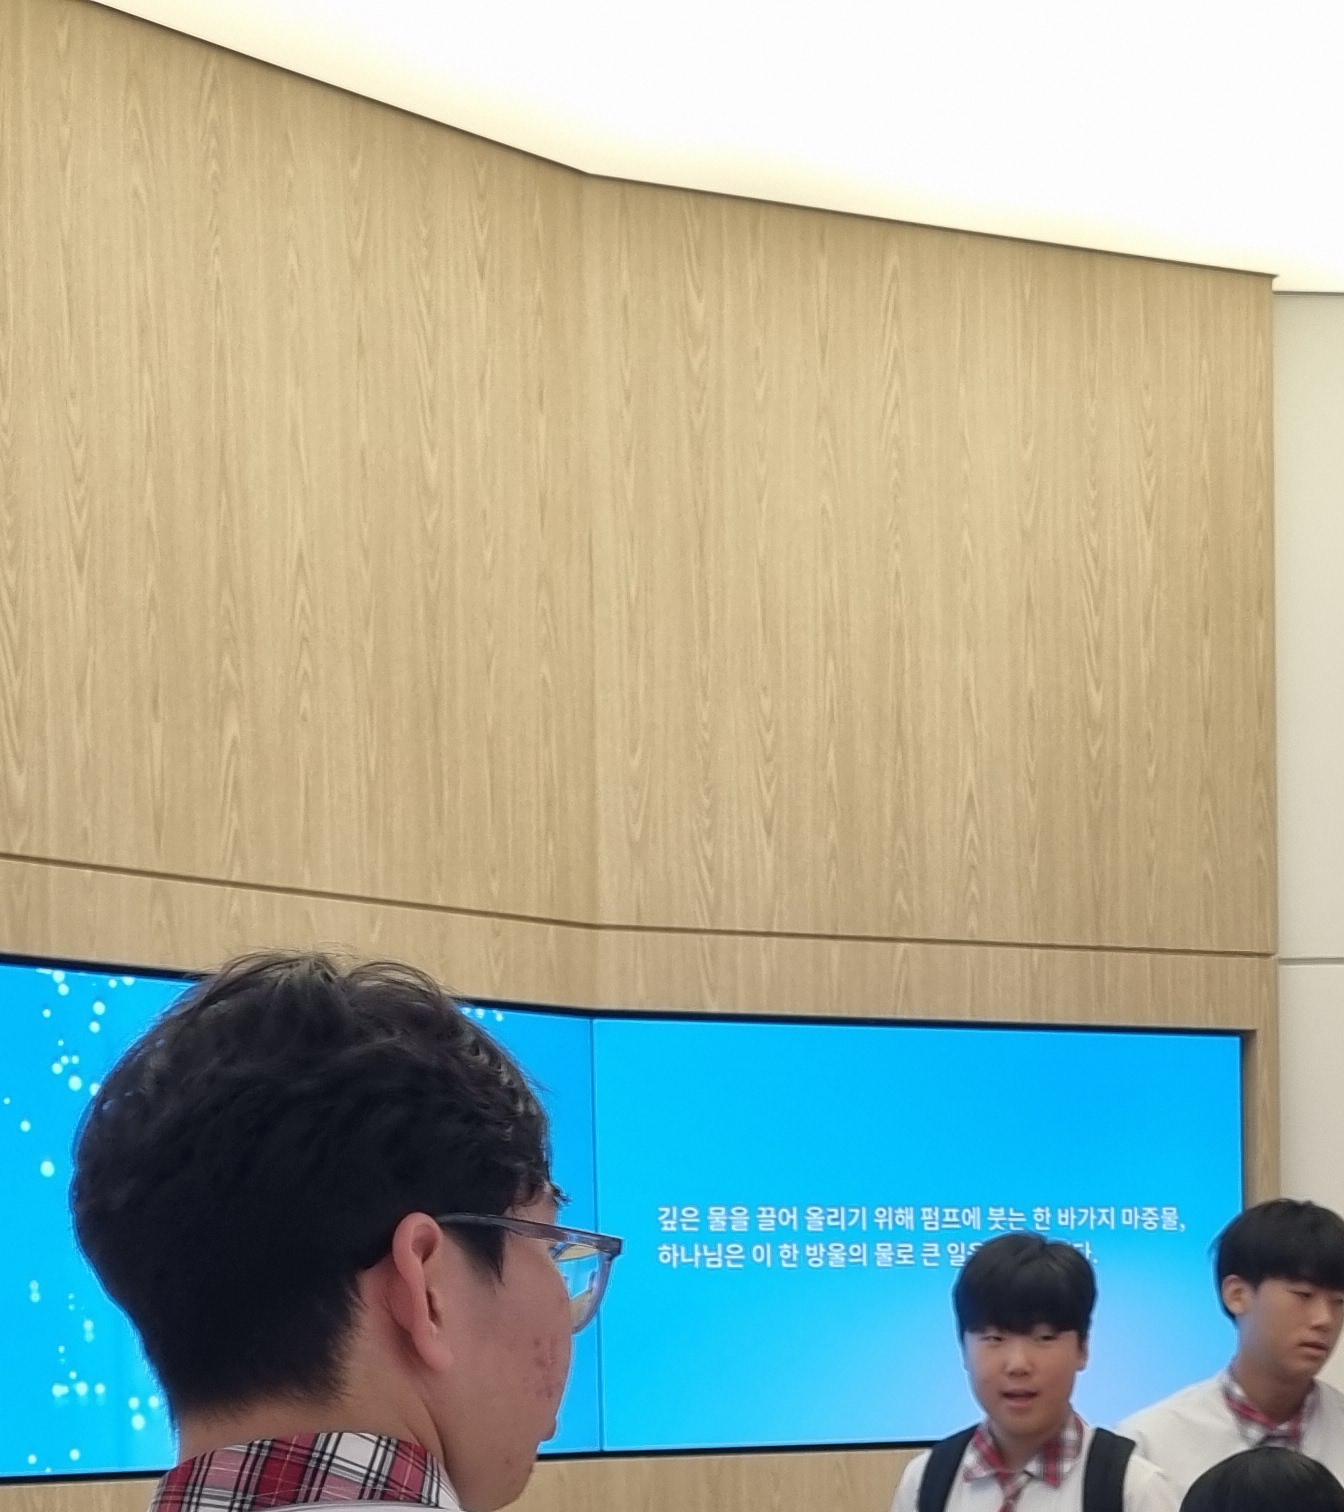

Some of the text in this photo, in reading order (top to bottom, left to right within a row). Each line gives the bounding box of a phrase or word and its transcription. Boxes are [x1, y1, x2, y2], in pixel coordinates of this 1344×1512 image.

[657, 1205, 1186, 1233] 깊은 물을 끌어 올리기 위해 펌프에 붓는 한 바가지 마중물,
[657, 1242, 746, 1269] 하나님은
[752, 1242, 771, 1268] 이
[778, 1242, 799, 1268] 한
[805, 1242, 868, 1268] 방울의
[874, 1242, 915, 1268] 물로
[921, 1242, 939, 1267] 큰
